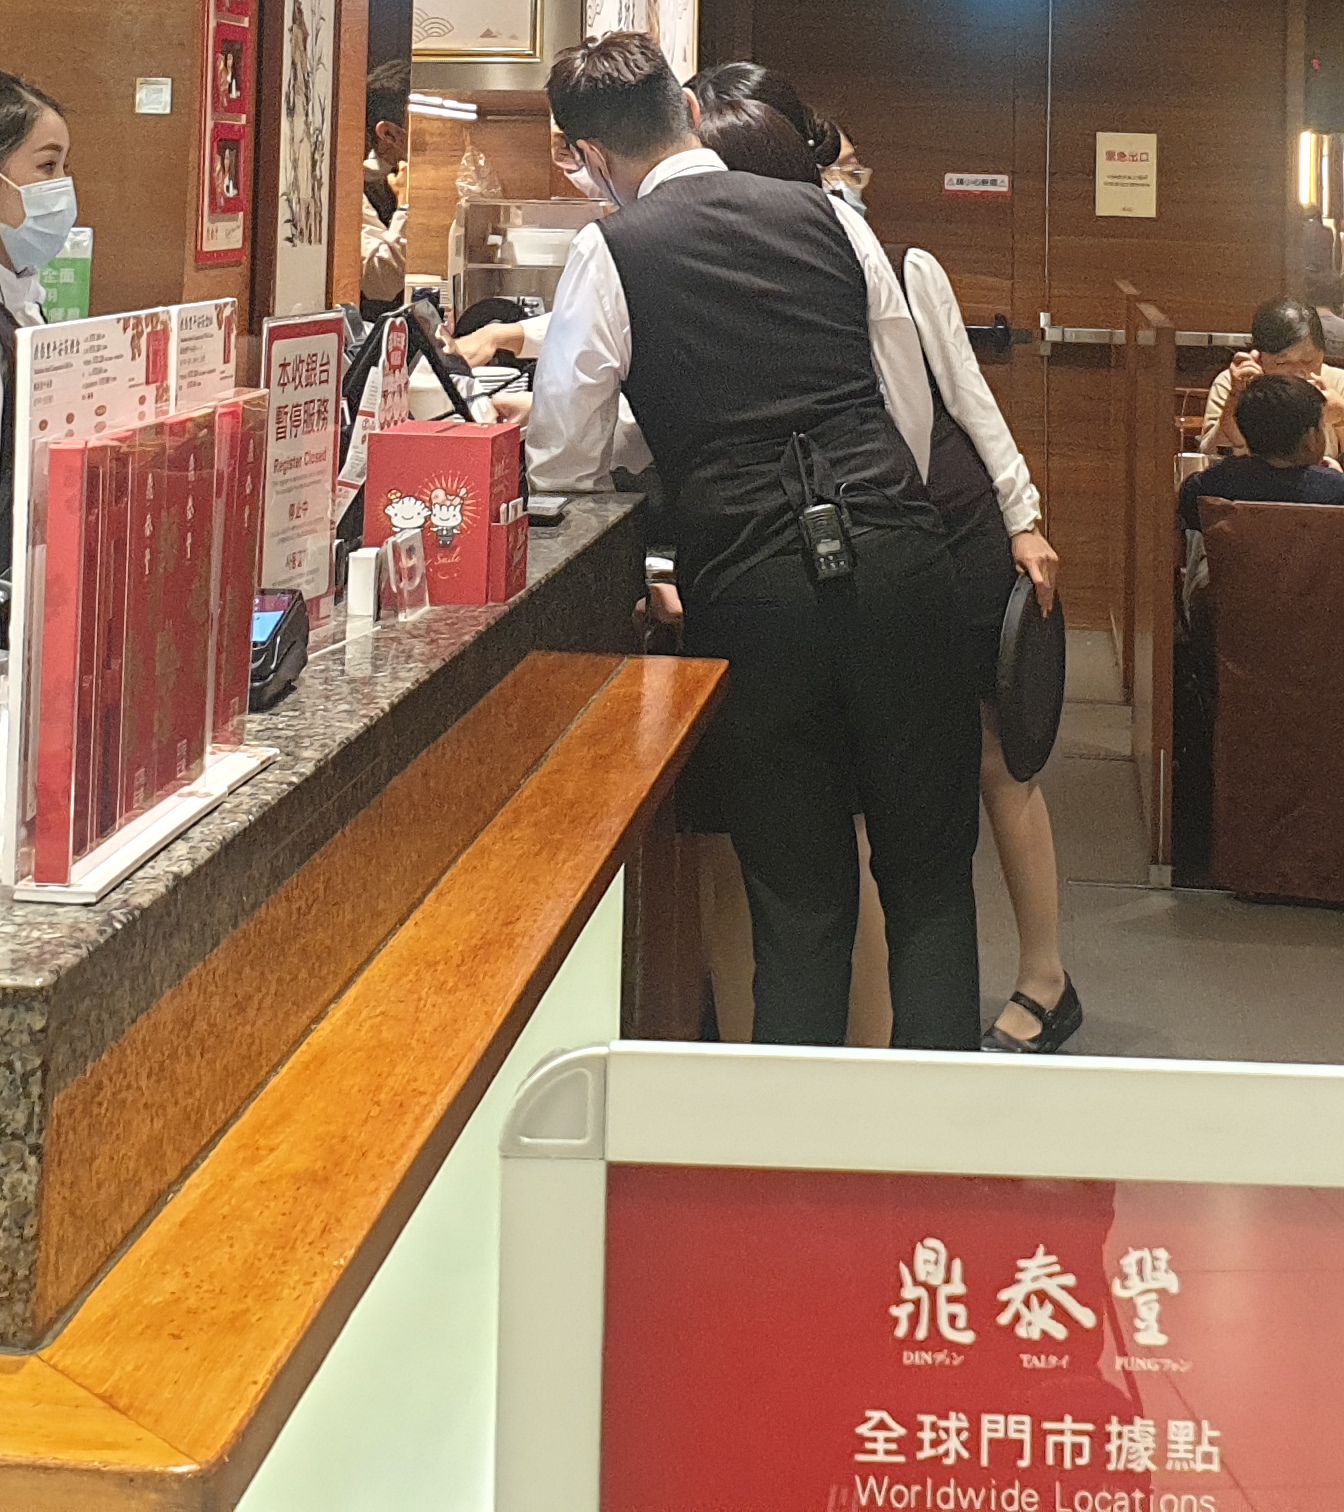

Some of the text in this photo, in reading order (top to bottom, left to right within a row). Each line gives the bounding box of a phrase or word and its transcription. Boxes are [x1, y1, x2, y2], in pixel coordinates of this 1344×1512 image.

[277, 350, 331, 394] 本收銀台
[275, 395, 330, 441] 暫停服務
[273, 448, 327, 475] Register Closed
[888, 1236, 1180, 1346] 鼎泰豐
[854, 1408, 1221, 1474] 全球門市據點
[854, 1474, 1218, 1512] Worldwide Locations
